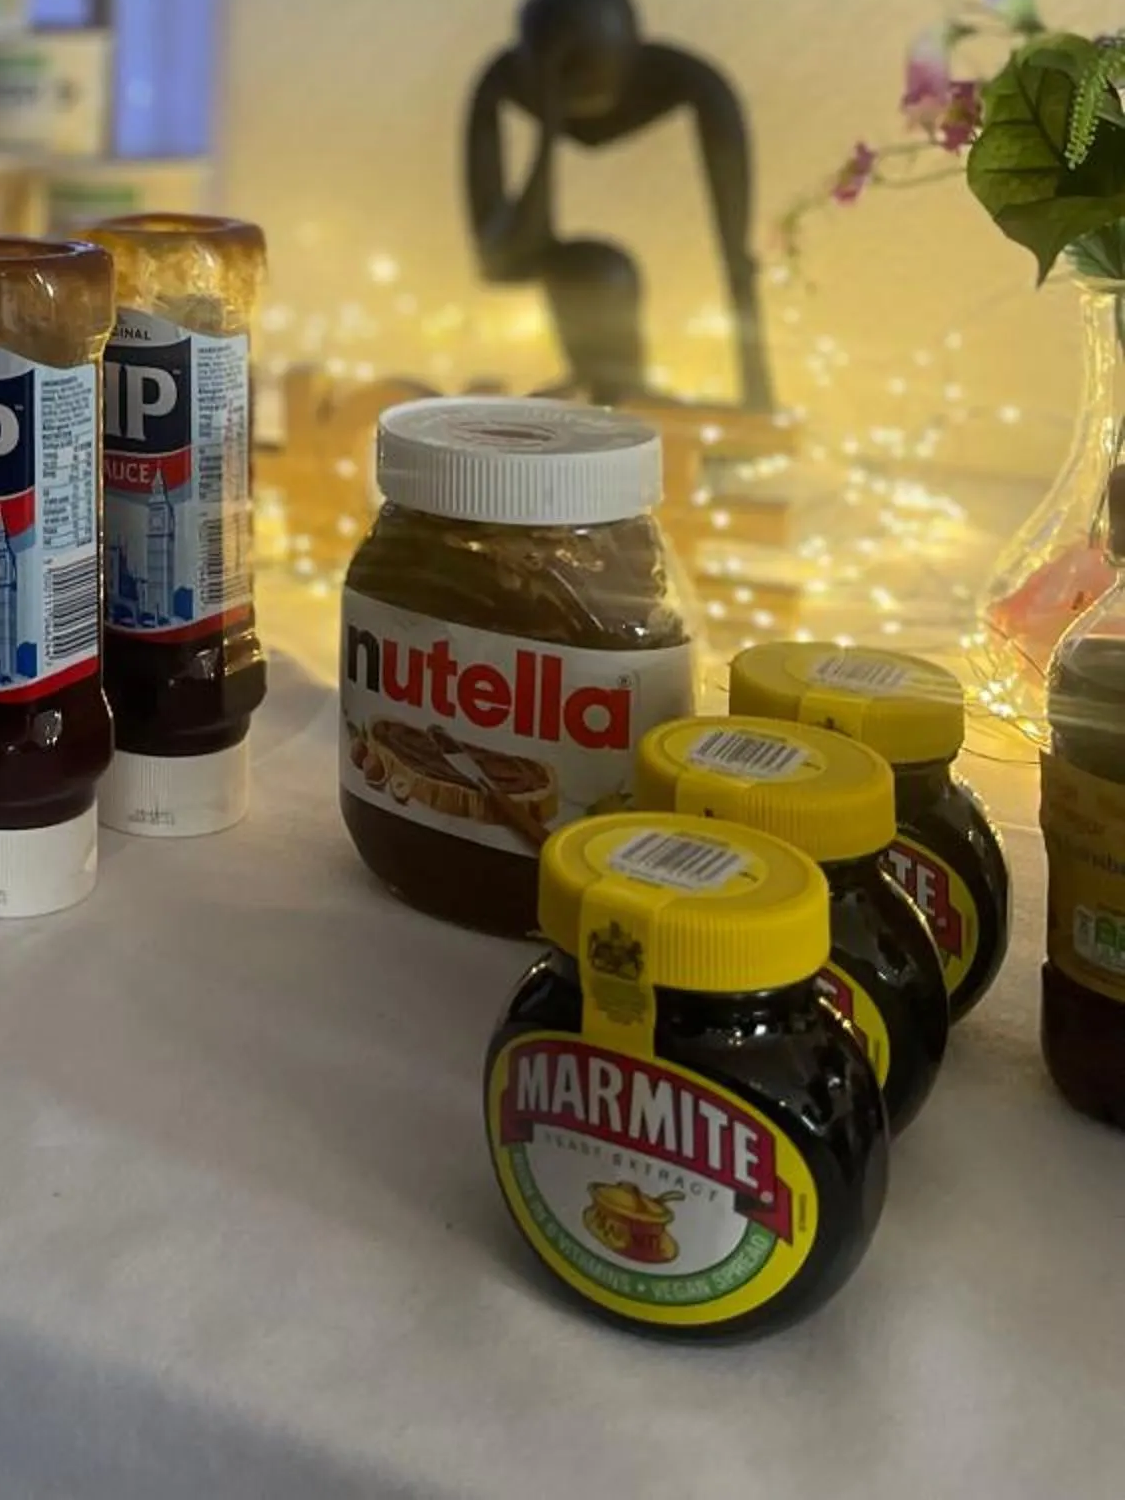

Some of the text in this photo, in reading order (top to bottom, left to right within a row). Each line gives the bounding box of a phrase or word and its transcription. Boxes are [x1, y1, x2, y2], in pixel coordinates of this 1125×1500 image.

[347, 625, 632, 751] nutella
[516, 1052, 760, 1188] MARMITE
[650, 1234, 766, 1302] VEGAN SPREAD
